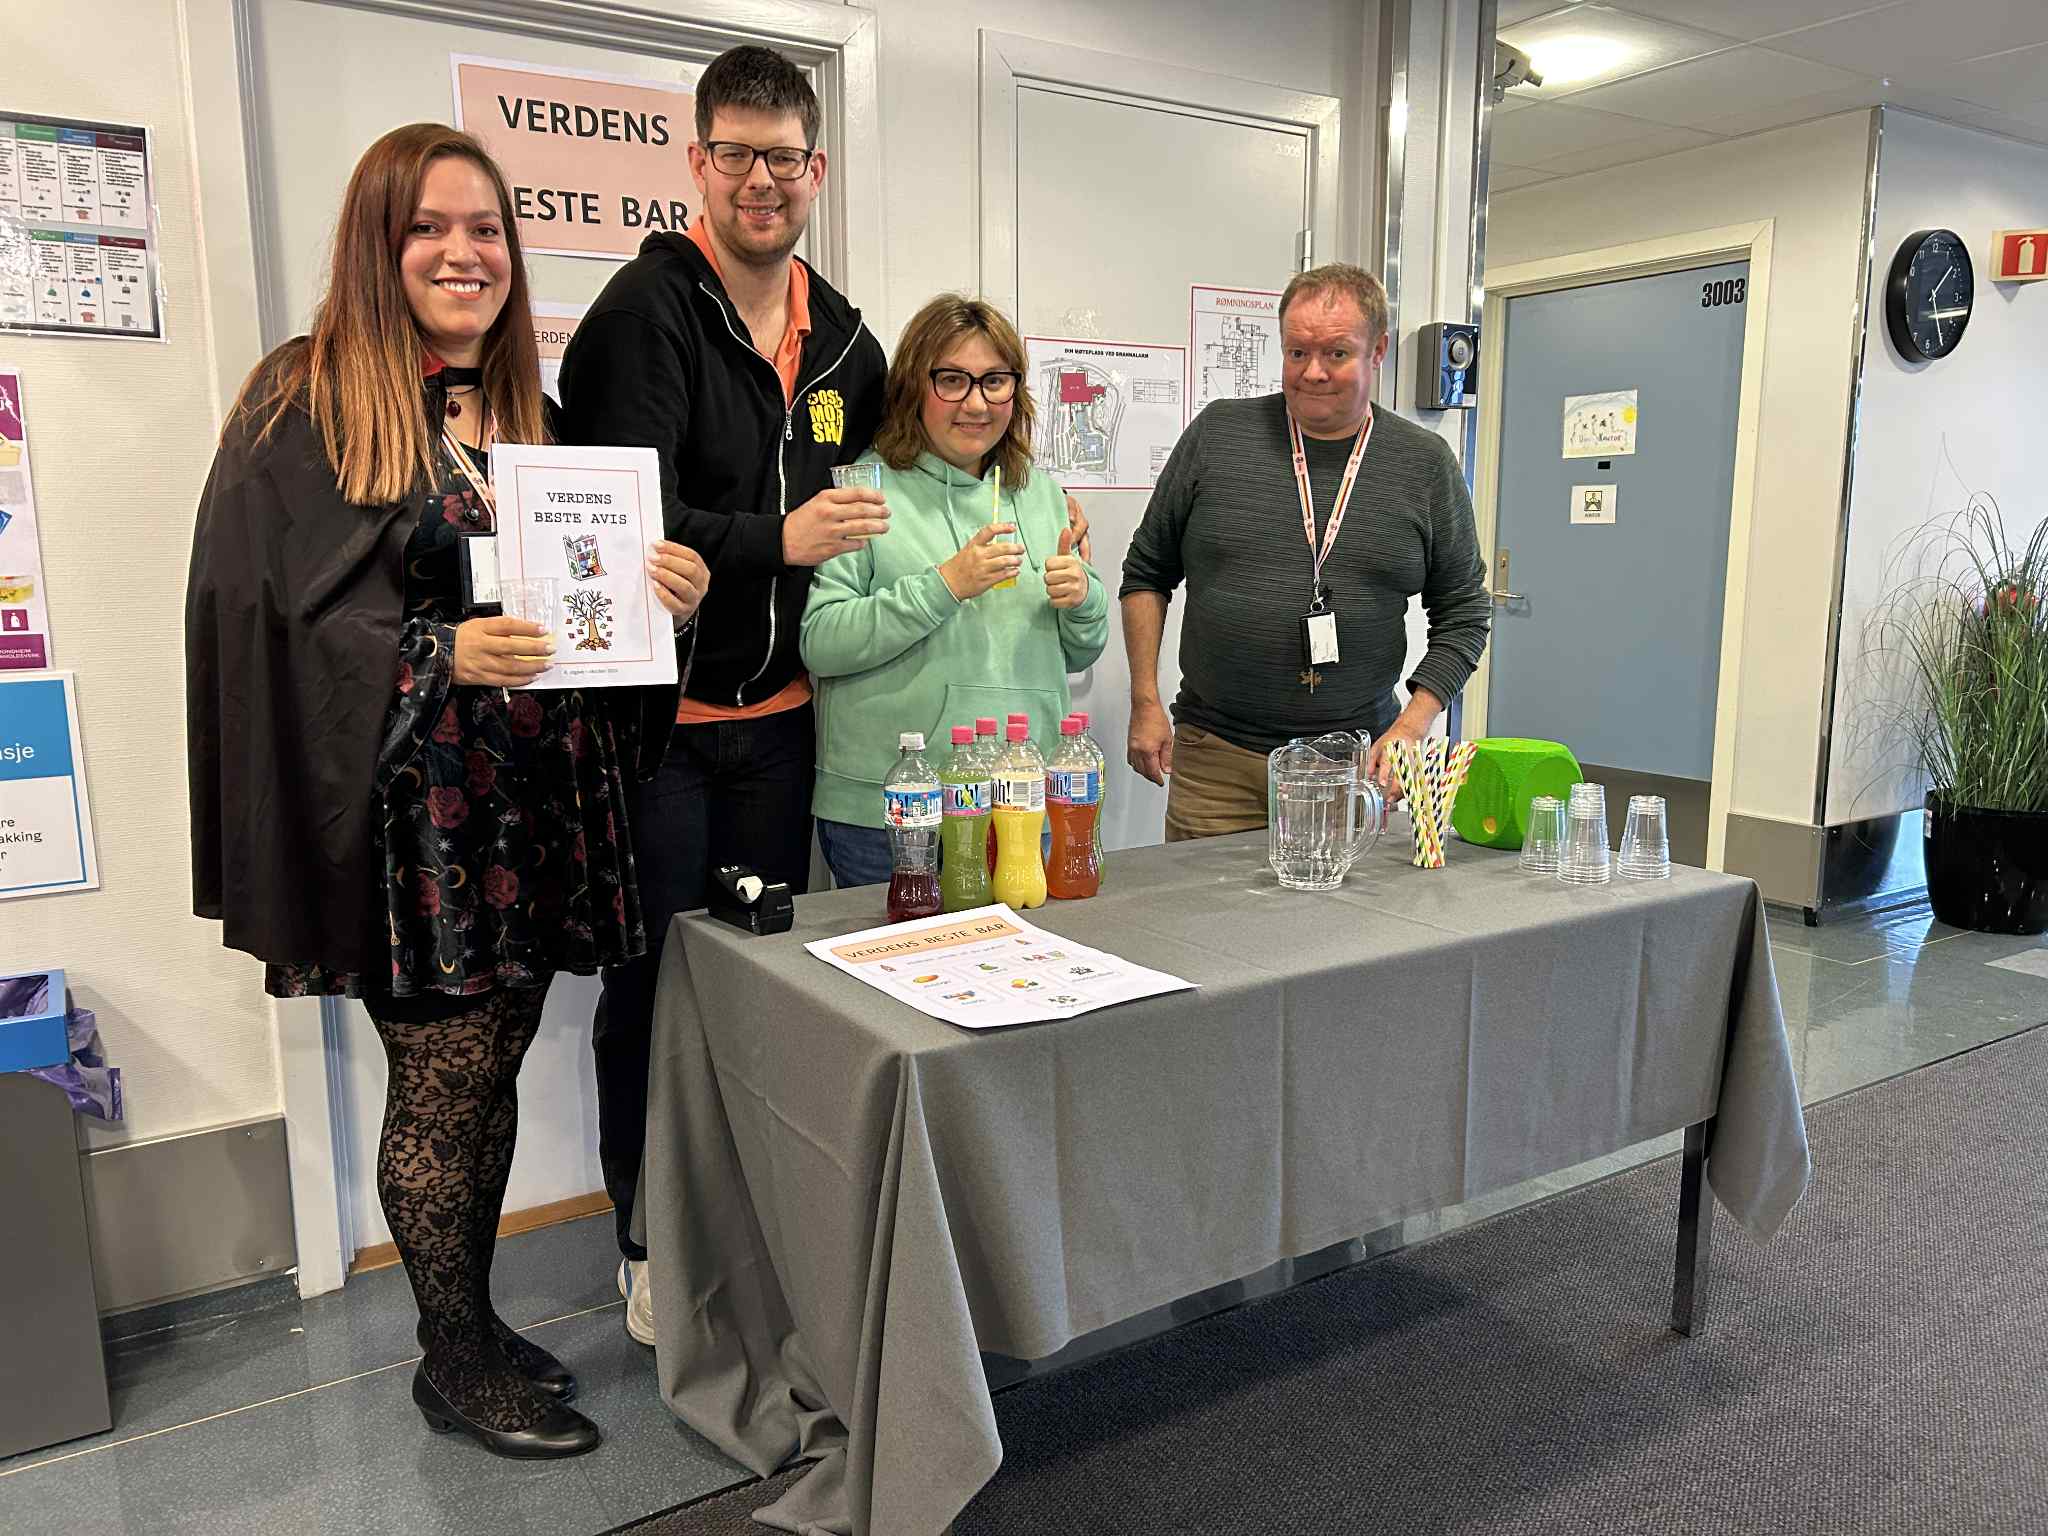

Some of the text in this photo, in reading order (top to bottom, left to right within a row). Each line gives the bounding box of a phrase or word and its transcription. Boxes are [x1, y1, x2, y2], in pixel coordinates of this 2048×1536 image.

[497, 95, 670, 146] VERDENS
[513, 186, 690, 231] ESTE BAR
[1701, 278, 1746, 308] 3003
[534, 330, 574, 345] ERDEN
[546, 491, 613, 505] VERDENS
[534, 511, 628, 525] BESTE AVIS
[845, 939, 920, 959] VERDENS
[924, 929, 972, 944] BESTE
[975, 922, 1007, 935] BAR
